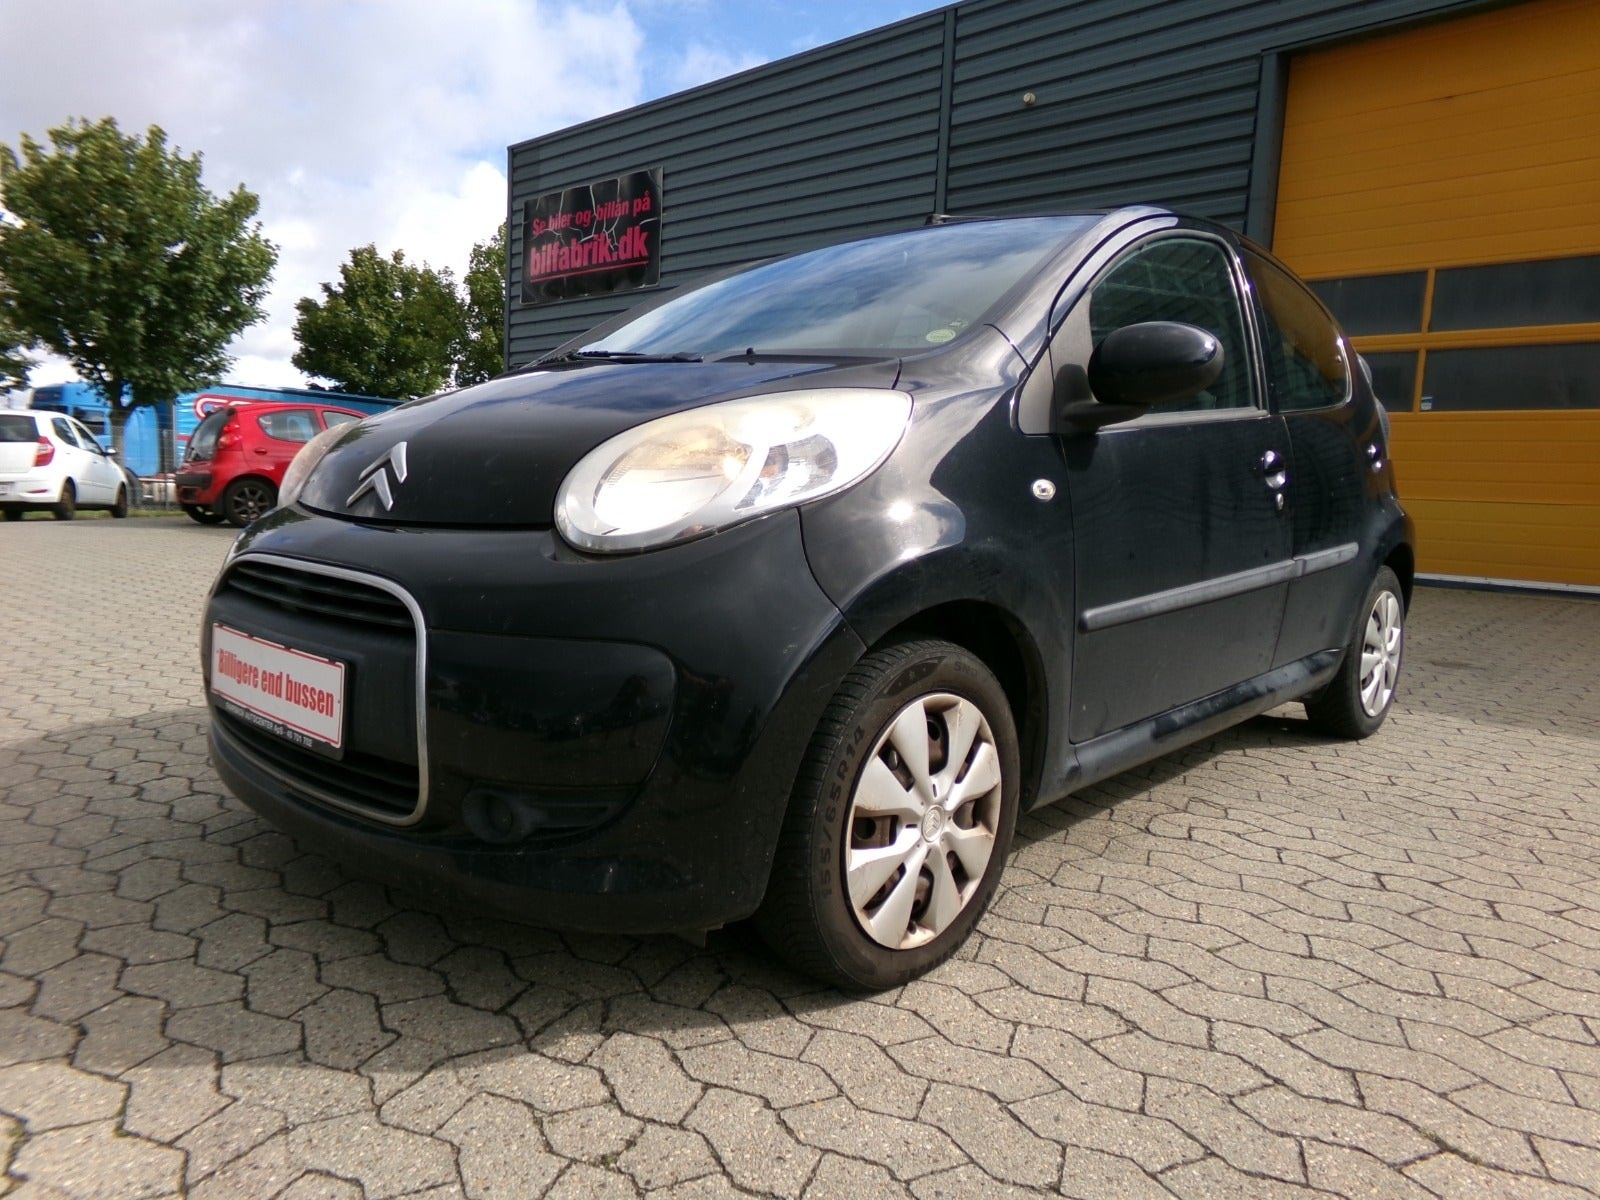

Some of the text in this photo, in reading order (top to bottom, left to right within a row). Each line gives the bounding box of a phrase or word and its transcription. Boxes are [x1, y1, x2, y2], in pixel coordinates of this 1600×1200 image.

[532, 190, 652, 236] Se biler og billån på
[531, 227, 648, 276] bilfabrik.dk
[218, 648, 334, 718] Billigere end bussen
